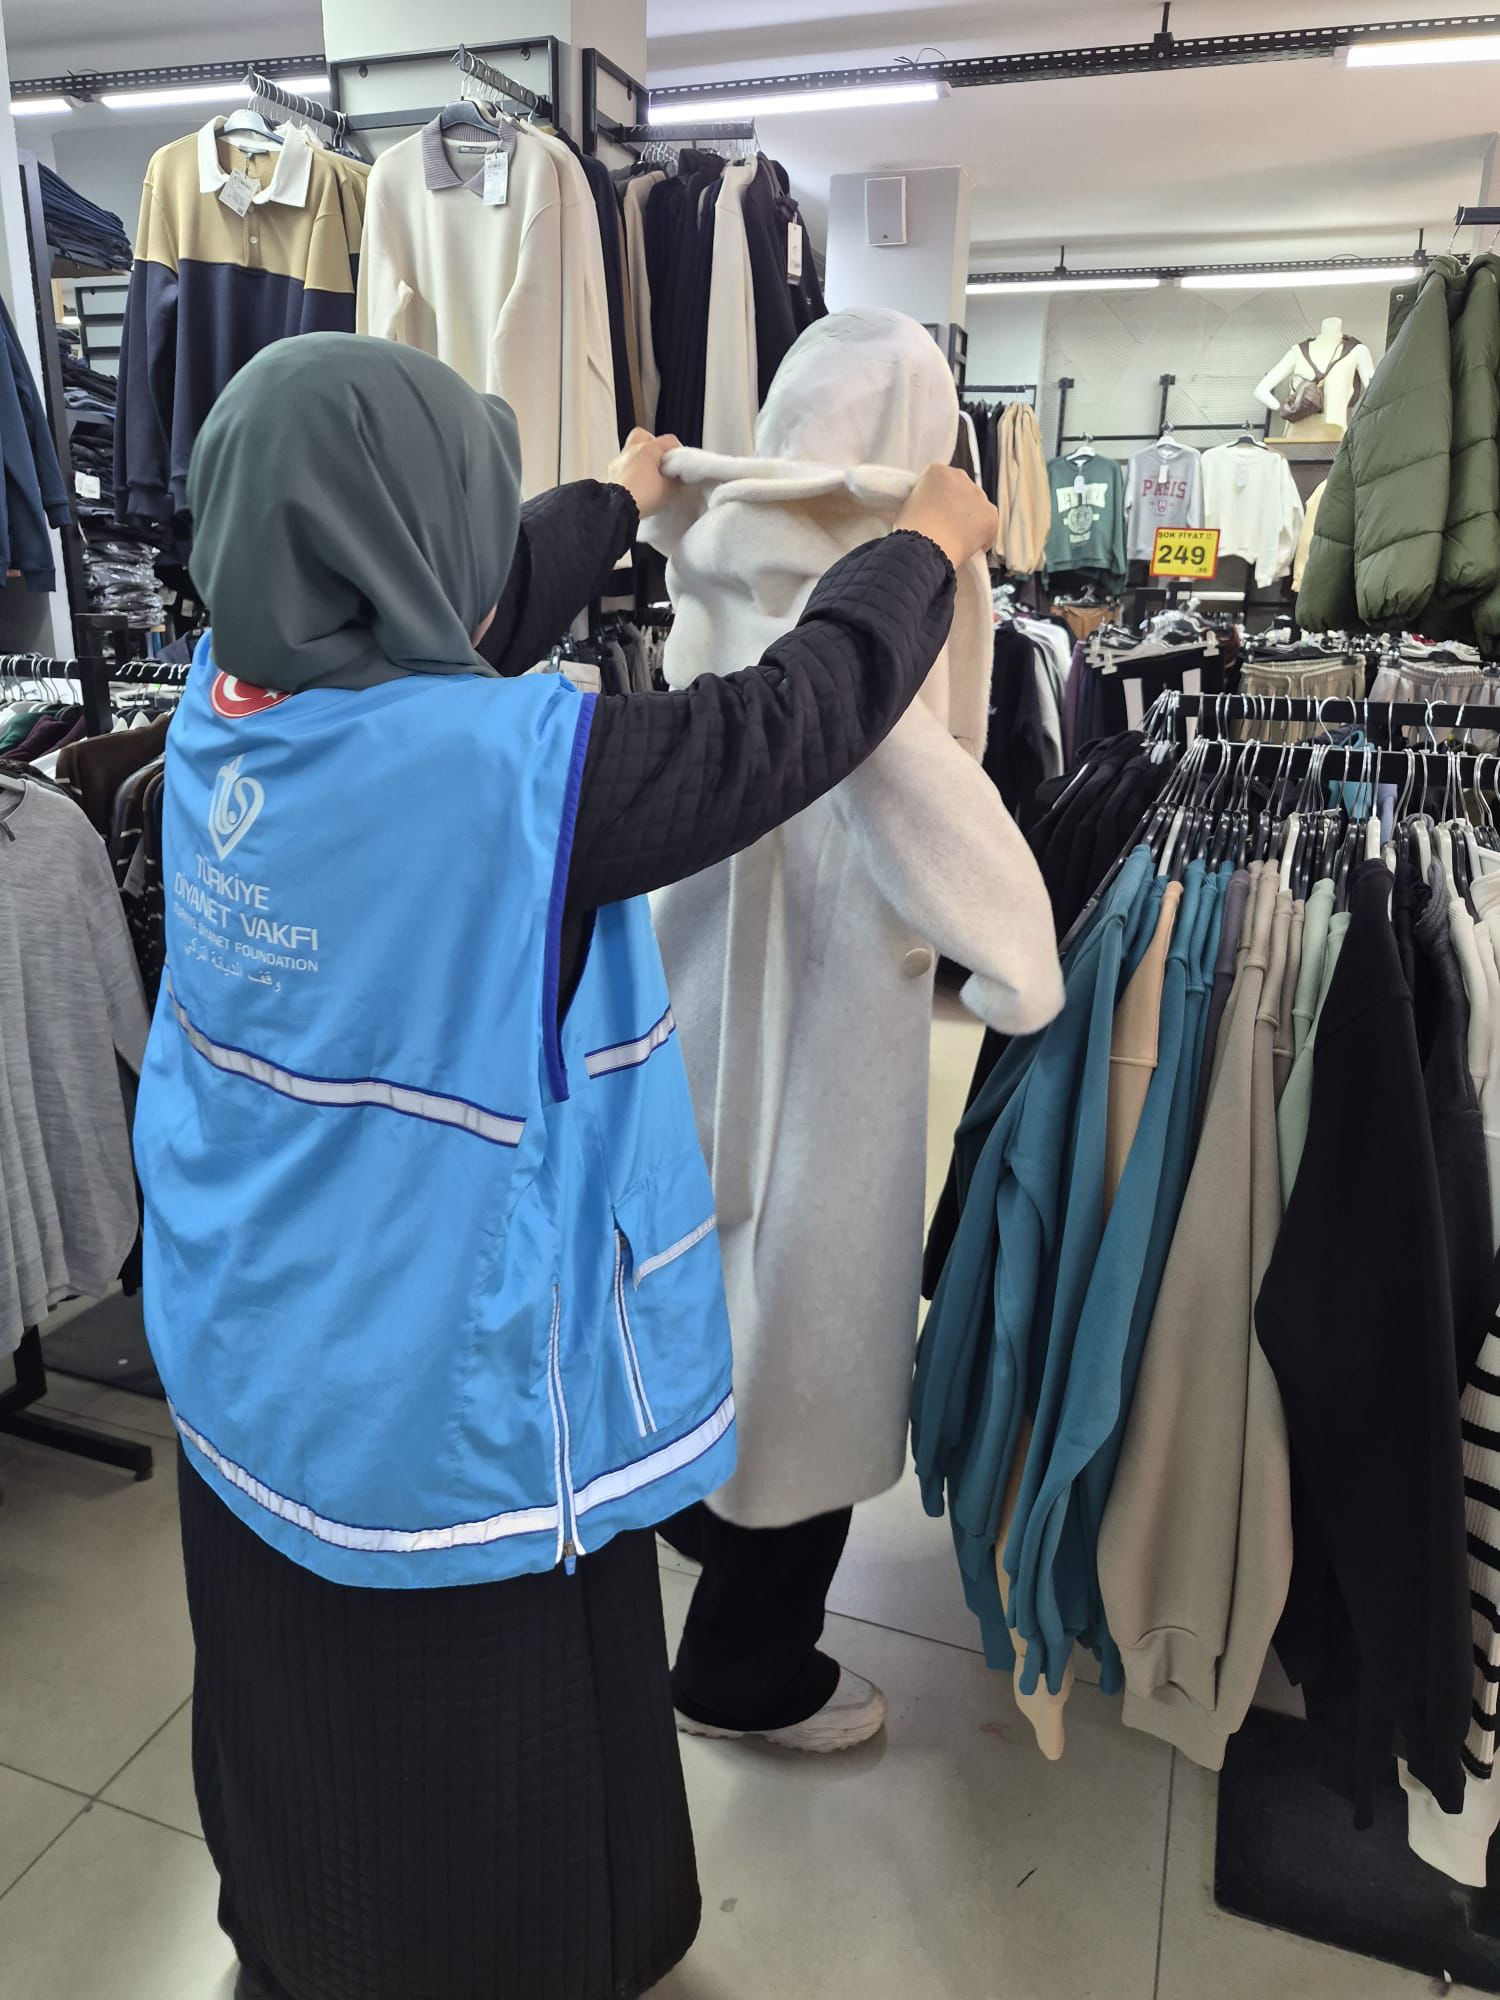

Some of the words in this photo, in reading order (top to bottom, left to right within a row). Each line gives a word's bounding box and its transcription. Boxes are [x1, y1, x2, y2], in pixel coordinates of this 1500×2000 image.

[1157, 544, 1206, 566] 249
[196, 853, 271, 911] TÜRKİYE
[173, 871, 232, 928] DİYANET
[240, 911, 319, 951] VAKFI
[234, 942, 319, 973] FOUNDATION
